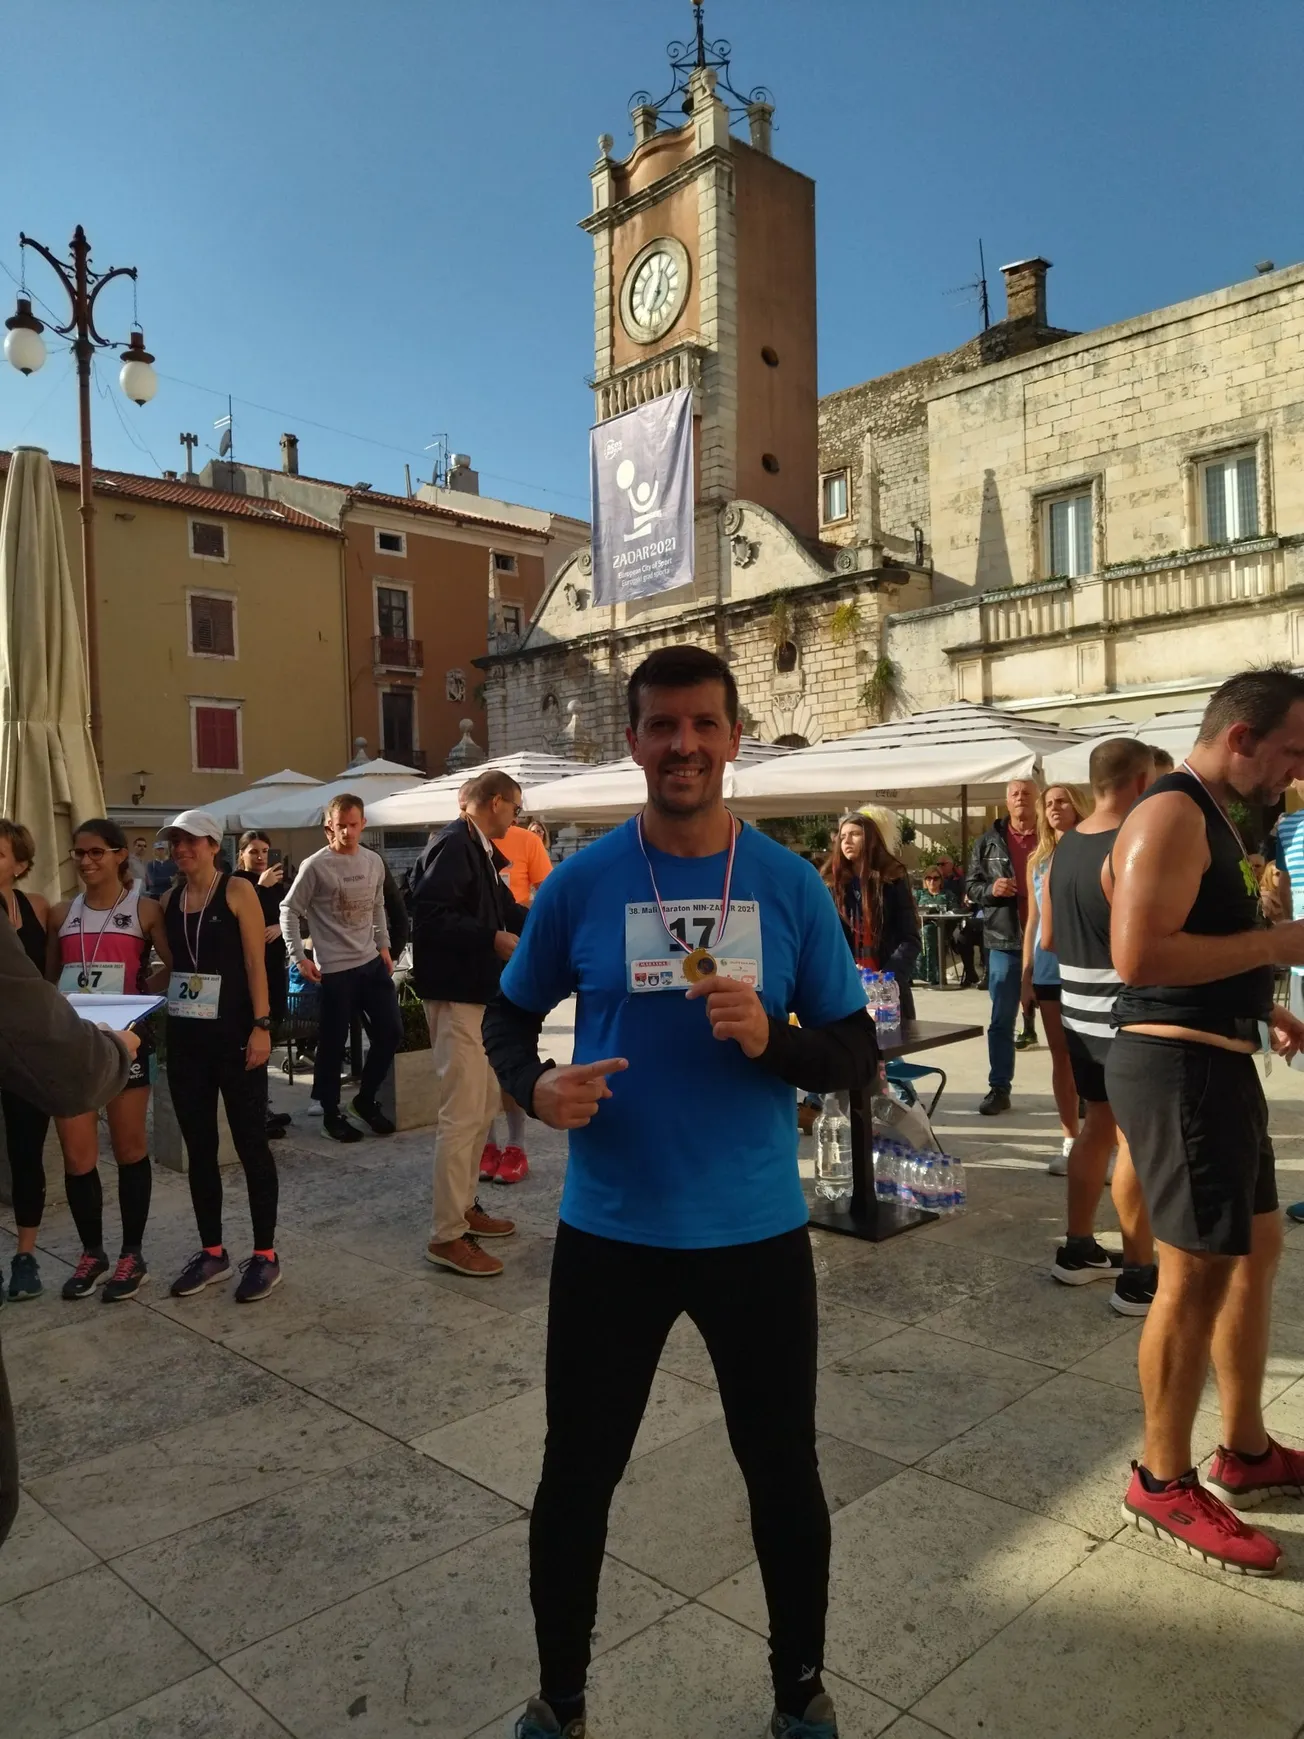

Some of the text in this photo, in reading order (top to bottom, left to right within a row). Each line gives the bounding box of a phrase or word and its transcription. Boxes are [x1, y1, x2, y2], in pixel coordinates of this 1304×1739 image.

[617, 568, 641, 579] European
[641, 564, 652, 573] City
[657, 558, 673, 567] Sport
[643, 571, 654, 582] grad
[629, 907, 640, 915] 38.
[641, 906, 658, 914] Mali
[692, 904, 736, 912] NIN-ZAR
[669, 917, 716, 952] 17
[77, 971, 102, 988] 67
